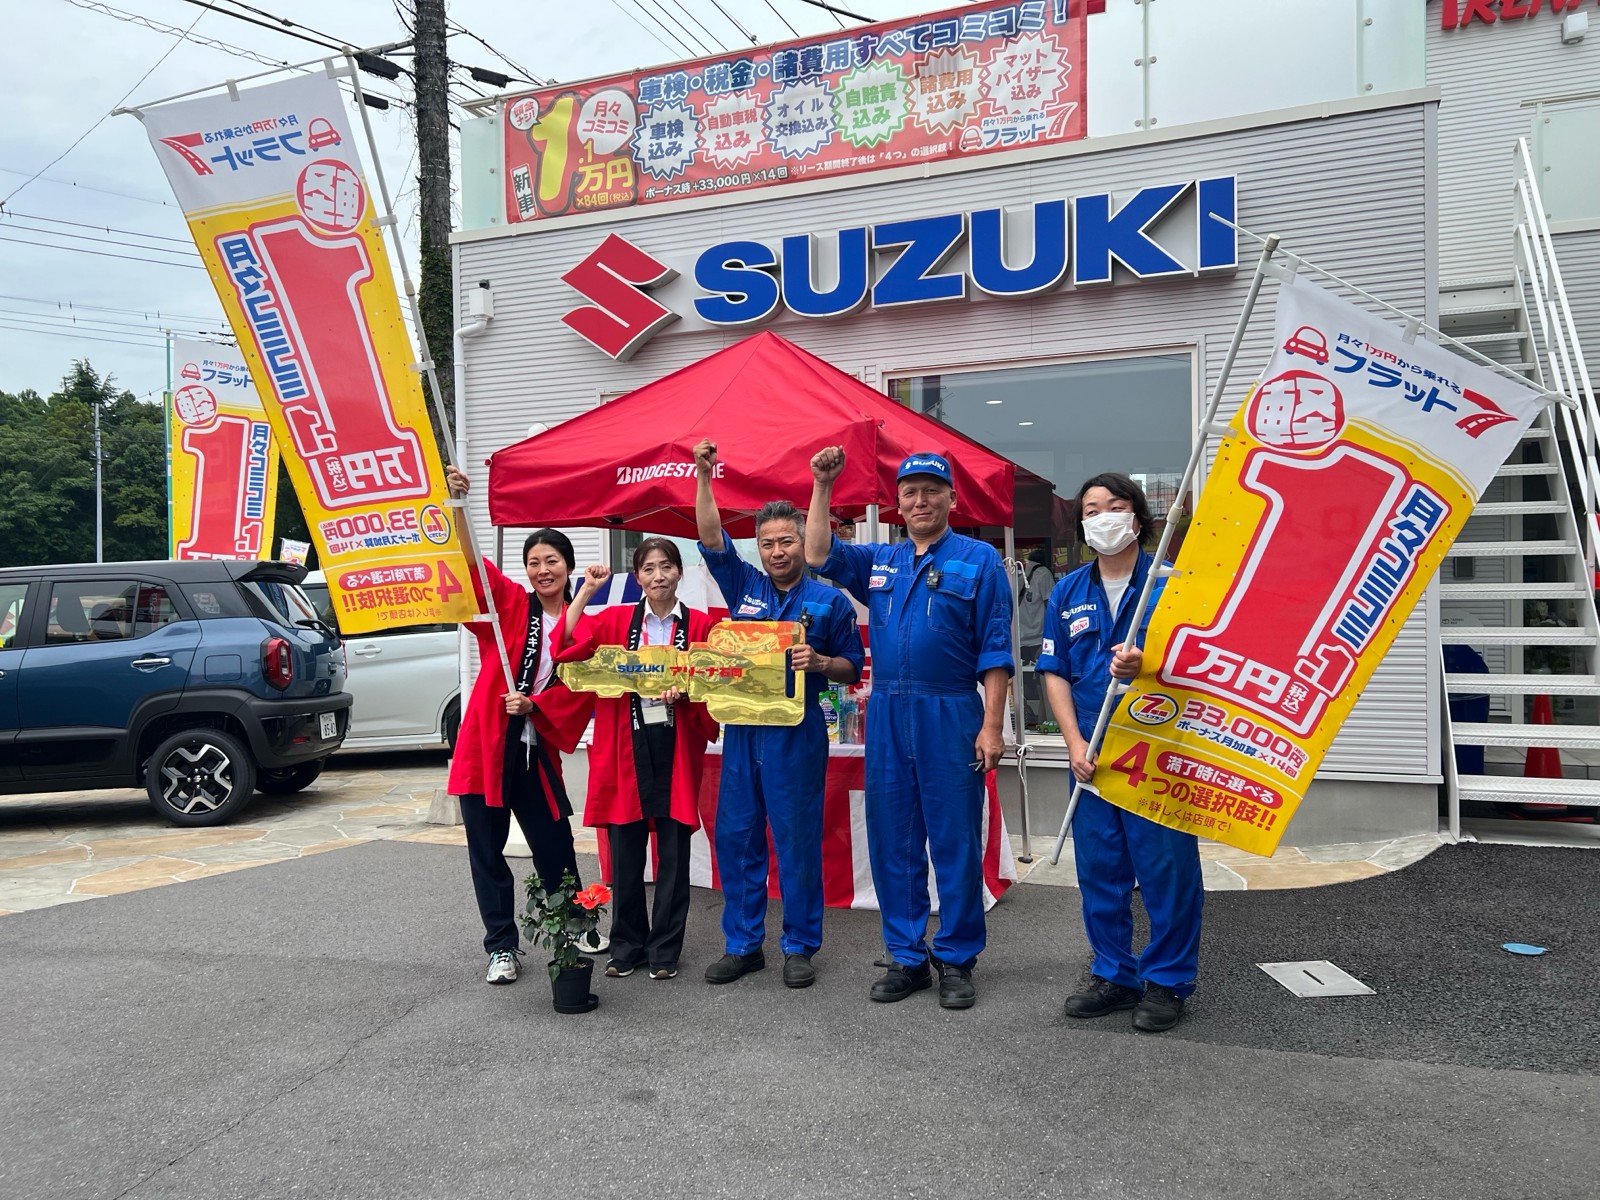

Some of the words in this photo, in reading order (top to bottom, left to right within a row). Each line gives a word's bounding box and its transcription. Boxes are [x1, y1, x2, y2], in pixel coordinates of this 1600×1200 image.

[1004, 48, 1048, 68] マット
[920, 70, 973, 95] 諸費用
[996, 66, 1056, 87] バイザー
[846, 82, 897, 105] 自賠責
[926, 90, 967, 114] 込み
[1010, 84, 1041, 101] 込み
[594, 101, 620, 117] 月々
[777, 97, 825, 118] オイル
[852, 104, 892, 129] 込み
[582, 117, 629, 135] コミコミ
[650, 120, 684, 140] 車検
[708, 108, 758, 131] 自動車税
[776, 116, 829, 138] 交換込み
[715, 130, 751, 151] 込み
[982, 123, 1046, 148] フラット
[649, 142, 683, 161] 込み
[513, 171, 536, 214] 新車
[693, 173, 1239, 327] SUZUKI
[1337, 332, 1462, 395] 月々1万円から乗れる
[201, 368, 254, 388] フラット
[1333, 345, 1458, 413] フラット
[1256, 376, 1336, 446] 軽
[246, 425, 269, 517] 月々コミコミ
[912, 460, 946, 472] SUZUKI
[1335, 488, 1444, 649] 月々コミコミ
[518, 616, 541, 695] スズキアリーナ
[617, 664, 665, 673] SUZUKI
[669, 666, 743, 678] アリーナ石岡
[1166, 756, 1275, 805] 満了時に選べる
